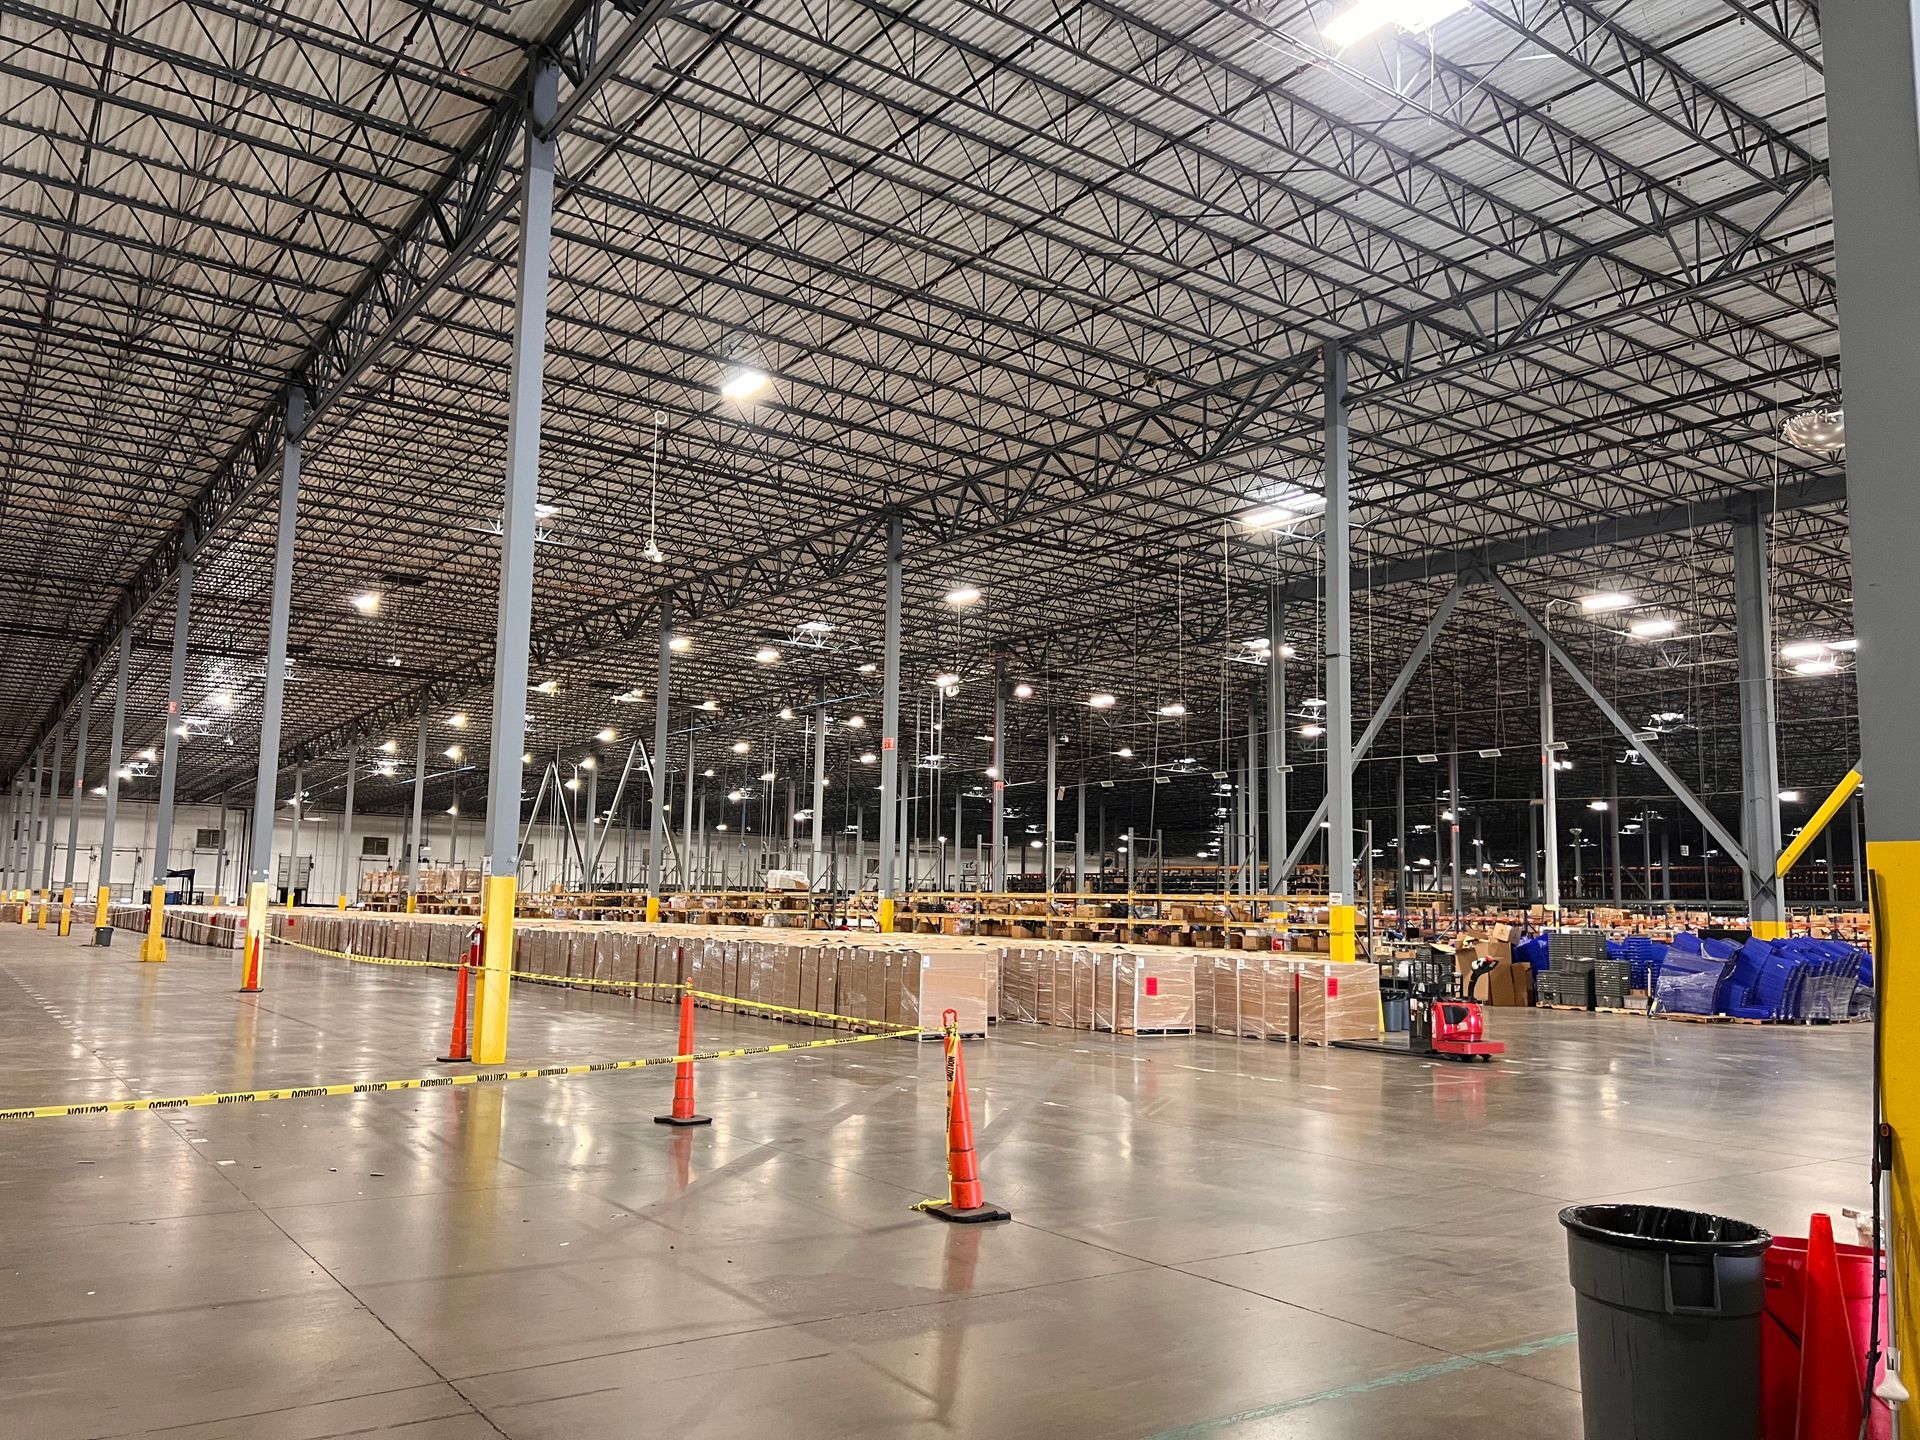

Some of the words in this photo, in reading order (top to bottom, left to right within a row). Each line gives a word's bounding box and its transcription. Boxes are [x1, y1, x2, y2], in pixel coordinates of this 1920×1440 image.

[589, 1063, 618, 1071] CAUTION
[947, 1056, 955, 1082] CAUTION
[420, 1078, 453, 1087] CUIDADO
[477, 1073, 507, 1082] CAUTION
[291, 1088, 327, 1098] CUIDADO
[353, 1083, 388, 1093] CAUTION
[218, 1093, 255, 1103] CAUTION
[149, 1099, 188, 1110] CUIDADO
[67, 1105, 108, 1115] CAUTION
[0, 1111, 35, 1120] CUIDAD
